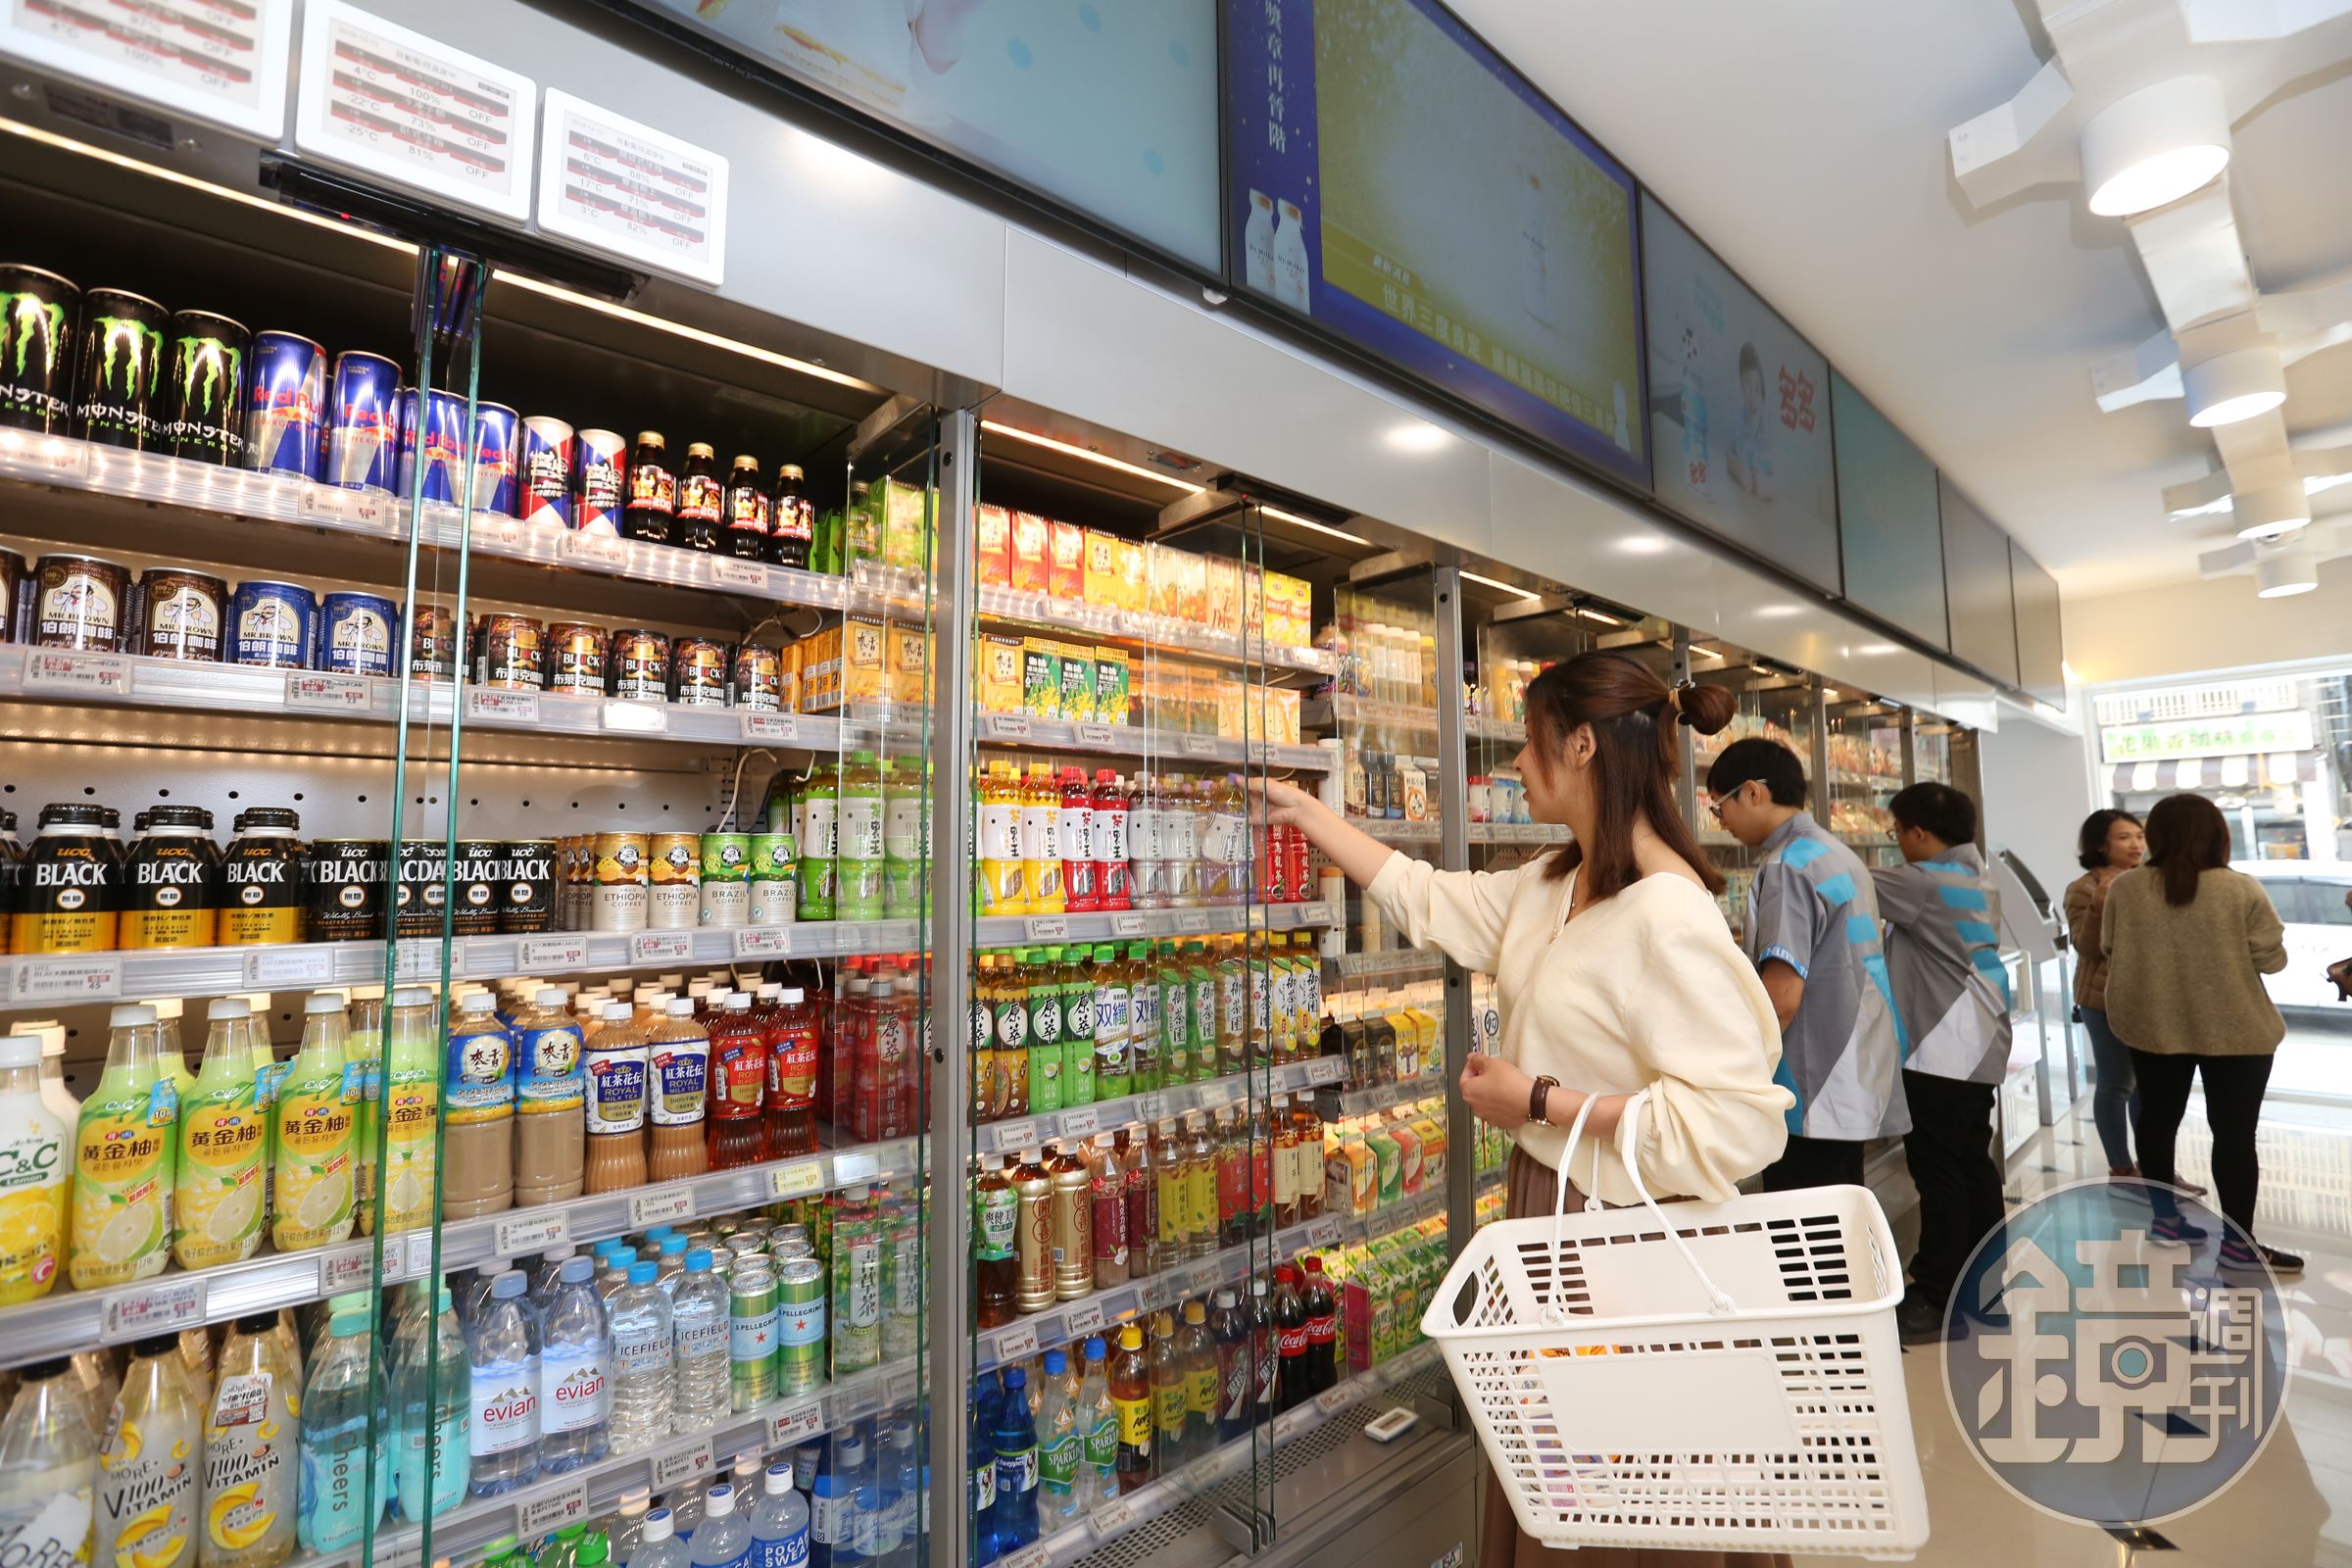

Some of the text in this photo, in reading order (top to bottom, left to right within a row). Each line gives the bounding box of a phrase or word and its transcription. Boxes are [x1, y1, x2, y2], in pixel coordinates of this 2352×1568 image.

[409, 86, 441, 106] 100%
[410, 116, 437, 133] 73%
[468, 110, 493, 124] OFF
[408, 145, 435, 162] 81%
[466, 137, 491, 151] OFF
[466, 165, 489, 179] OFF
[674, 187, 693, 199] OFF
[673, 213, 693, 224] OFF
[672, 238, 691, 249] OFF
[0, 383, 69, 416] NSTER
[254, 386, 322, 416] Red Bull
[344, 404, 378, 422] Red
[652, 498, 672, 510] 200
[701, 506, 719, 518] 200
[41, 621, 114, 640] 伯朗咖啡
[153, 632, 218, 650] 伯朗咖啡
[239, 640, 298, 656] 伯朗咖啡
[332, 649, 387, 664] 伯朗咖啡
[35, 863, 109, 886] BLACK
[137, 862, 204, 884] BLACK
[227, 862, 285, 883] BLACK
[320, 859, 377, 882] BLACK
[454, 859, 500, 881] BLACK
[501, 859, 550, 880] BLACK
[61, 894, 82, 904] 無糖
[160, 892, 178, 901] 無糖
[244, 891, 262, 900] 無糖
[471, 890, 487, 899] 無糖
[605, 892, 647, 902] ETHIOPIA
[657, 892, 697, 901] ETHIOPIA
[712, 890, 747, 899] BRAZIL
[763, 889, 795, 898] BRAZIL
[1286, 976, 1297, 1017] 御茶園
[1306, 972, 1318, 1012] 御茶園
[1201, 986, 1215, 1038] 御茶園
[1230, 981, 1243, 1032] 御茶園
[1004, 1003, 1021, 1049] 原萃
[1039, 998, 1056, 1044] 原萃
[1073, 994, 1090, 1039] 原萃
[470, 1049, 503, 1073] 麥香
[543, 1042, 572, 1065] 麥香
[601, 1071, 643, 1088] 紅茶花伝
[665, 1064, 704, 1079] 紅茶花伝
[605, 1087, 637, 1097] ROYAL
[669, 1079, 699, 1088] ROYAL
[285, 1117, 344, 1135] 黃金柚
[191, 1125, 256, 1148] 黃金柚
[0, 1142, 59, 1177] C&C
[83, 1140, 152, 1161] 黃金柚
[6, 1174, 43, 1186] Lemon
[681, 1320, 729, 1341] ICEFIELD
[736, 1316, 777, 1331] S.PELLEGRIN
[620, 1336, 670, 1356] ICEFIELD
[556, 1376, 605, 1400] evian
[484, 1396, 536, 1422] evian
[1091, 1430, 1118, 1449] SPARKL
[1049, 1447, 1078, 1466] SPARKL
[331, 1432, 349, 1512] Cheers
[765, 1531, 809, 1558] POCAR
